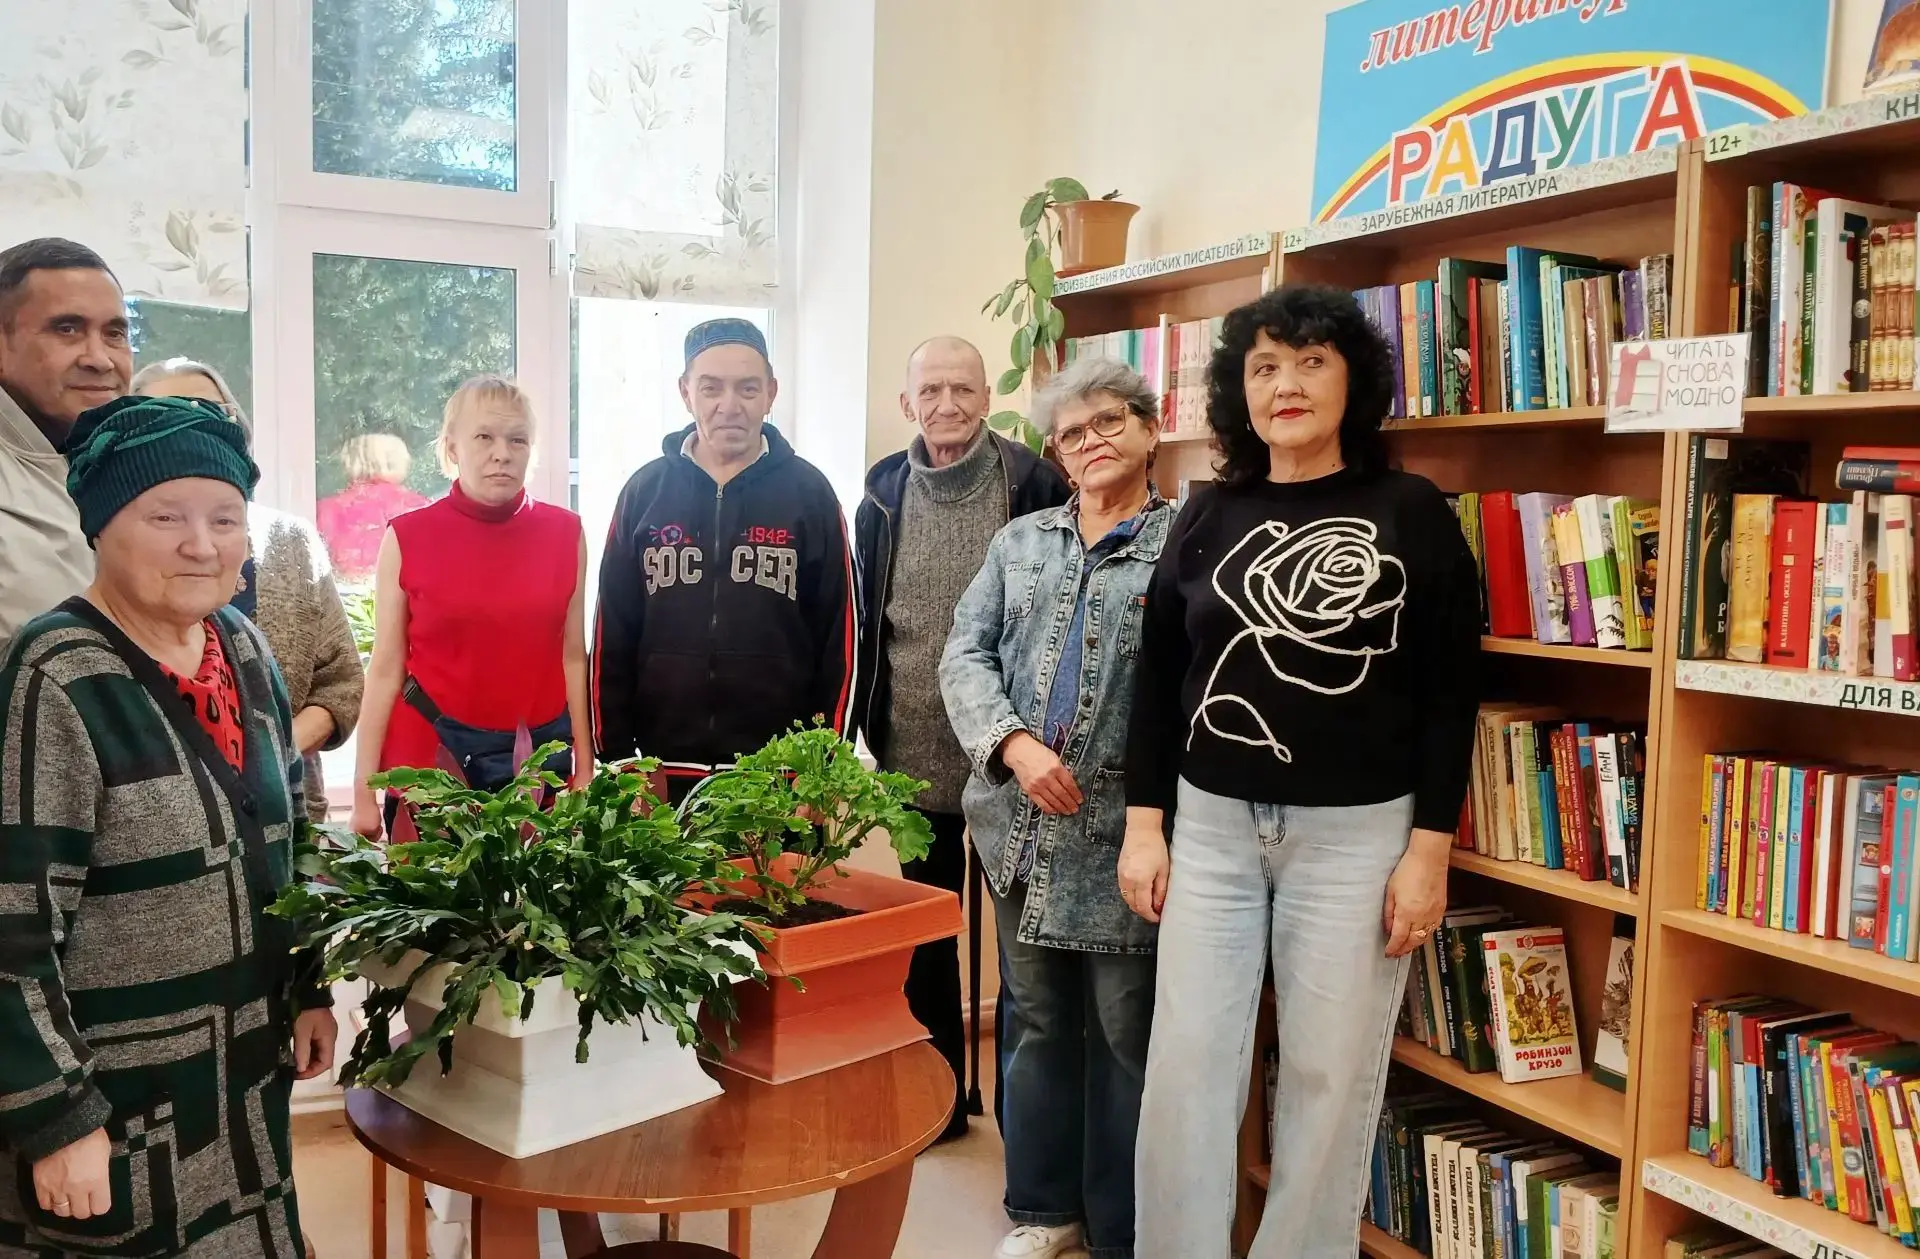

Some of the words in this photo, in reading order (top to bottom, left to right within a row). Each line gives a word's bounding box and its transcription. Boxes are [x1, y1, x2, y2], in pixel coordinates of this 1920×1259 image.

[1361, 0, 1625, 71] литера
[1389, 64, 1702, 202] РАДУГА
[1709, 135, 1741, 154] 12+
[1361, 198, 1453, 232] ЗАРУБЕЖНАЯ
[1458, 176, 1558, 211] ЛИТЕРАТУРА
[1283, 235, 1302, 248] 12+
[1053, 271, 1118, 295] ПРОИЗВЕДЕНИЯ
[1119, 259, 1181, 281] РОССИЙСКИХ
[1184, 238, 1244, 268] ПИСАТЕЛЕЙ
[1248, 239, 1265, 251] 12+
[1804, 271, 1812, 319] ЛИТЕРАТУРА
[1667, 340, 1735, 359] ЧИТАТЬ
[1666, 362, 1734, 383] СНОВА
[1665, 386, 1735, 407] МОДНО
[1564, 564, 1577, 593] ЯНССОН
[1780, 600, 1789, 647] ВАЛЕНТИНА
[1839, 684, 1891, 708] ДЛЯ
[1901, 690, 1920, 711] В
[1515, 1045, 1573, 1061] РОБИНЗОН
[1529, 1058, 1563, 1071] КРУЗО
[1430, 1153, 1439, 1190] НИОТКУДА
[1448, 1159, 1456, 1197] НИОТКУДА
[1465, 1166, 1473, 1204] НИОТКУДА
